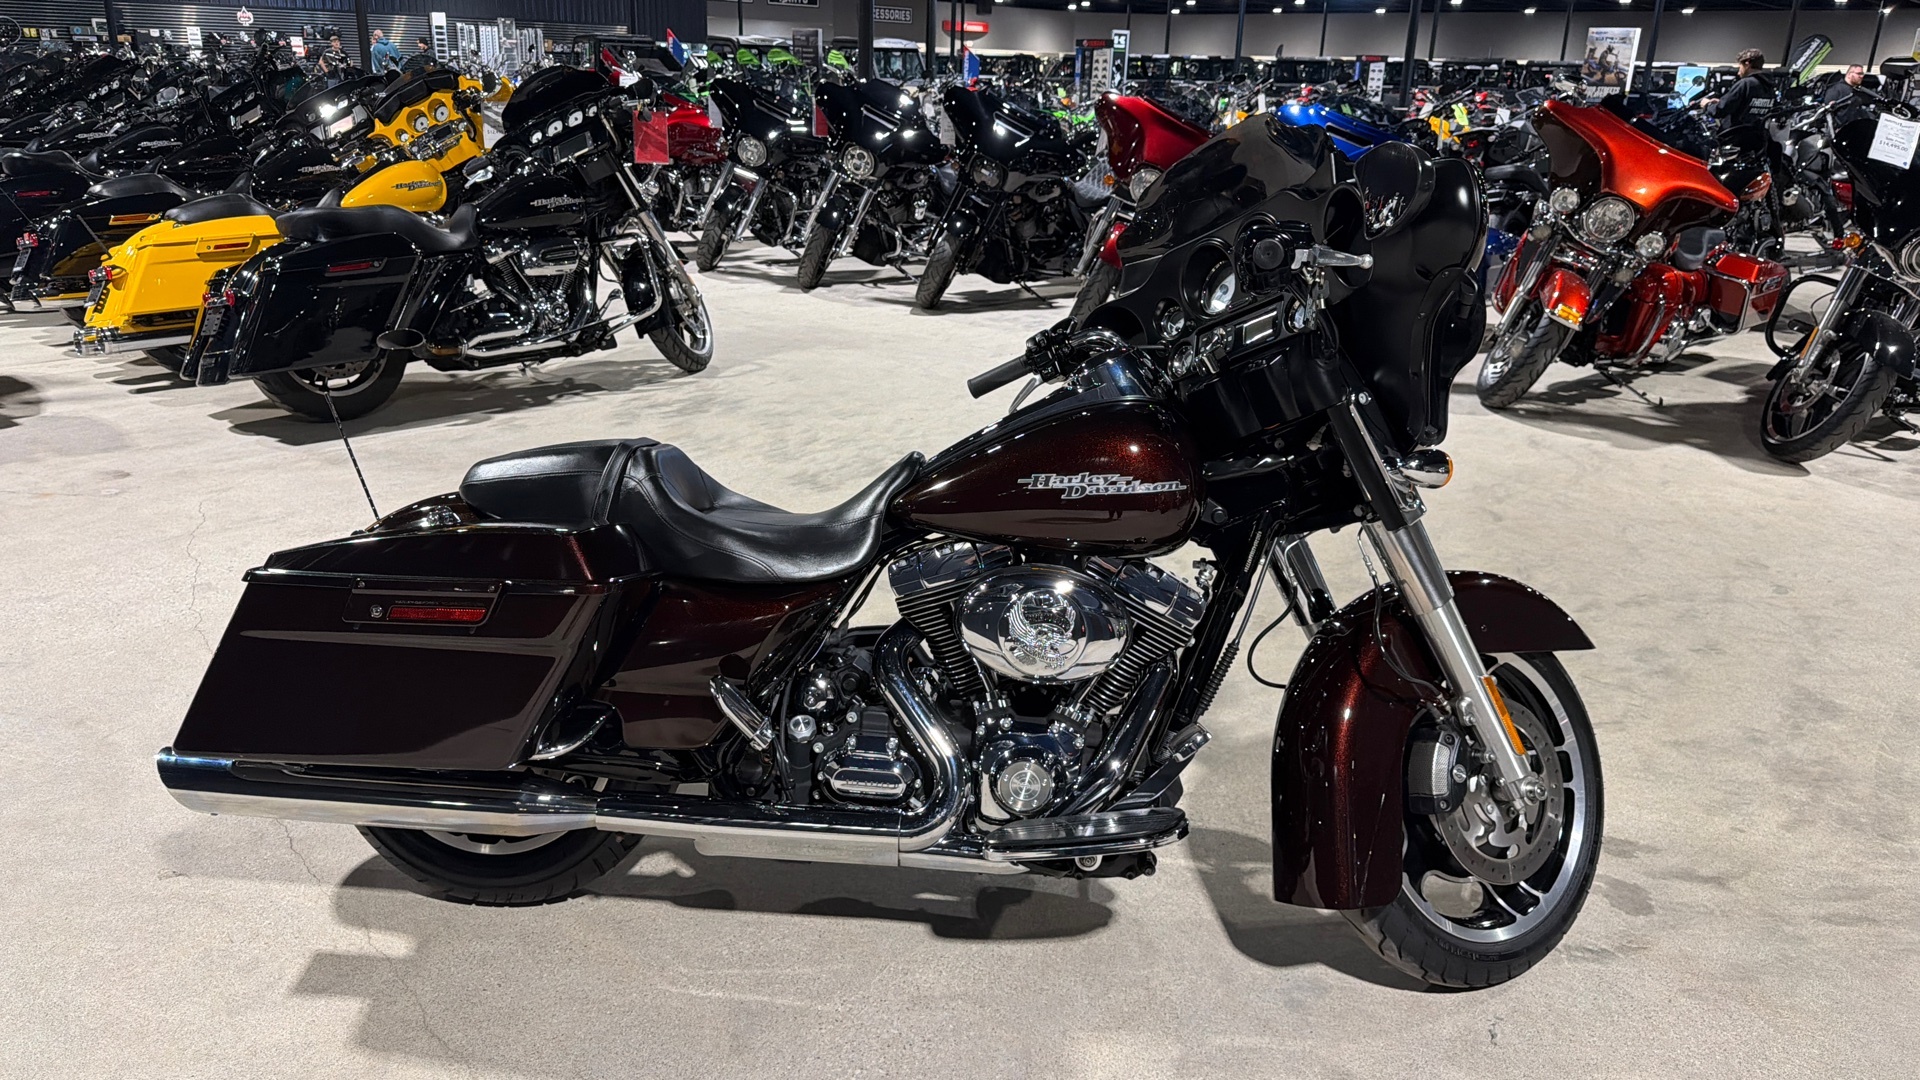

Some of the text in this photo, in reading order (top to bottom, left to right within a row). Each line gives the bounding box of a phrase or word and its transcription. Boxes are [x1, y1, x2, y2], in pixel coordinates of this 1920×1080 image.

[873, 8, 910, 21] ESSORIES
[1027, 472, 1121, 490] Harley
[1060, 480, 1187, 500] Davidson
